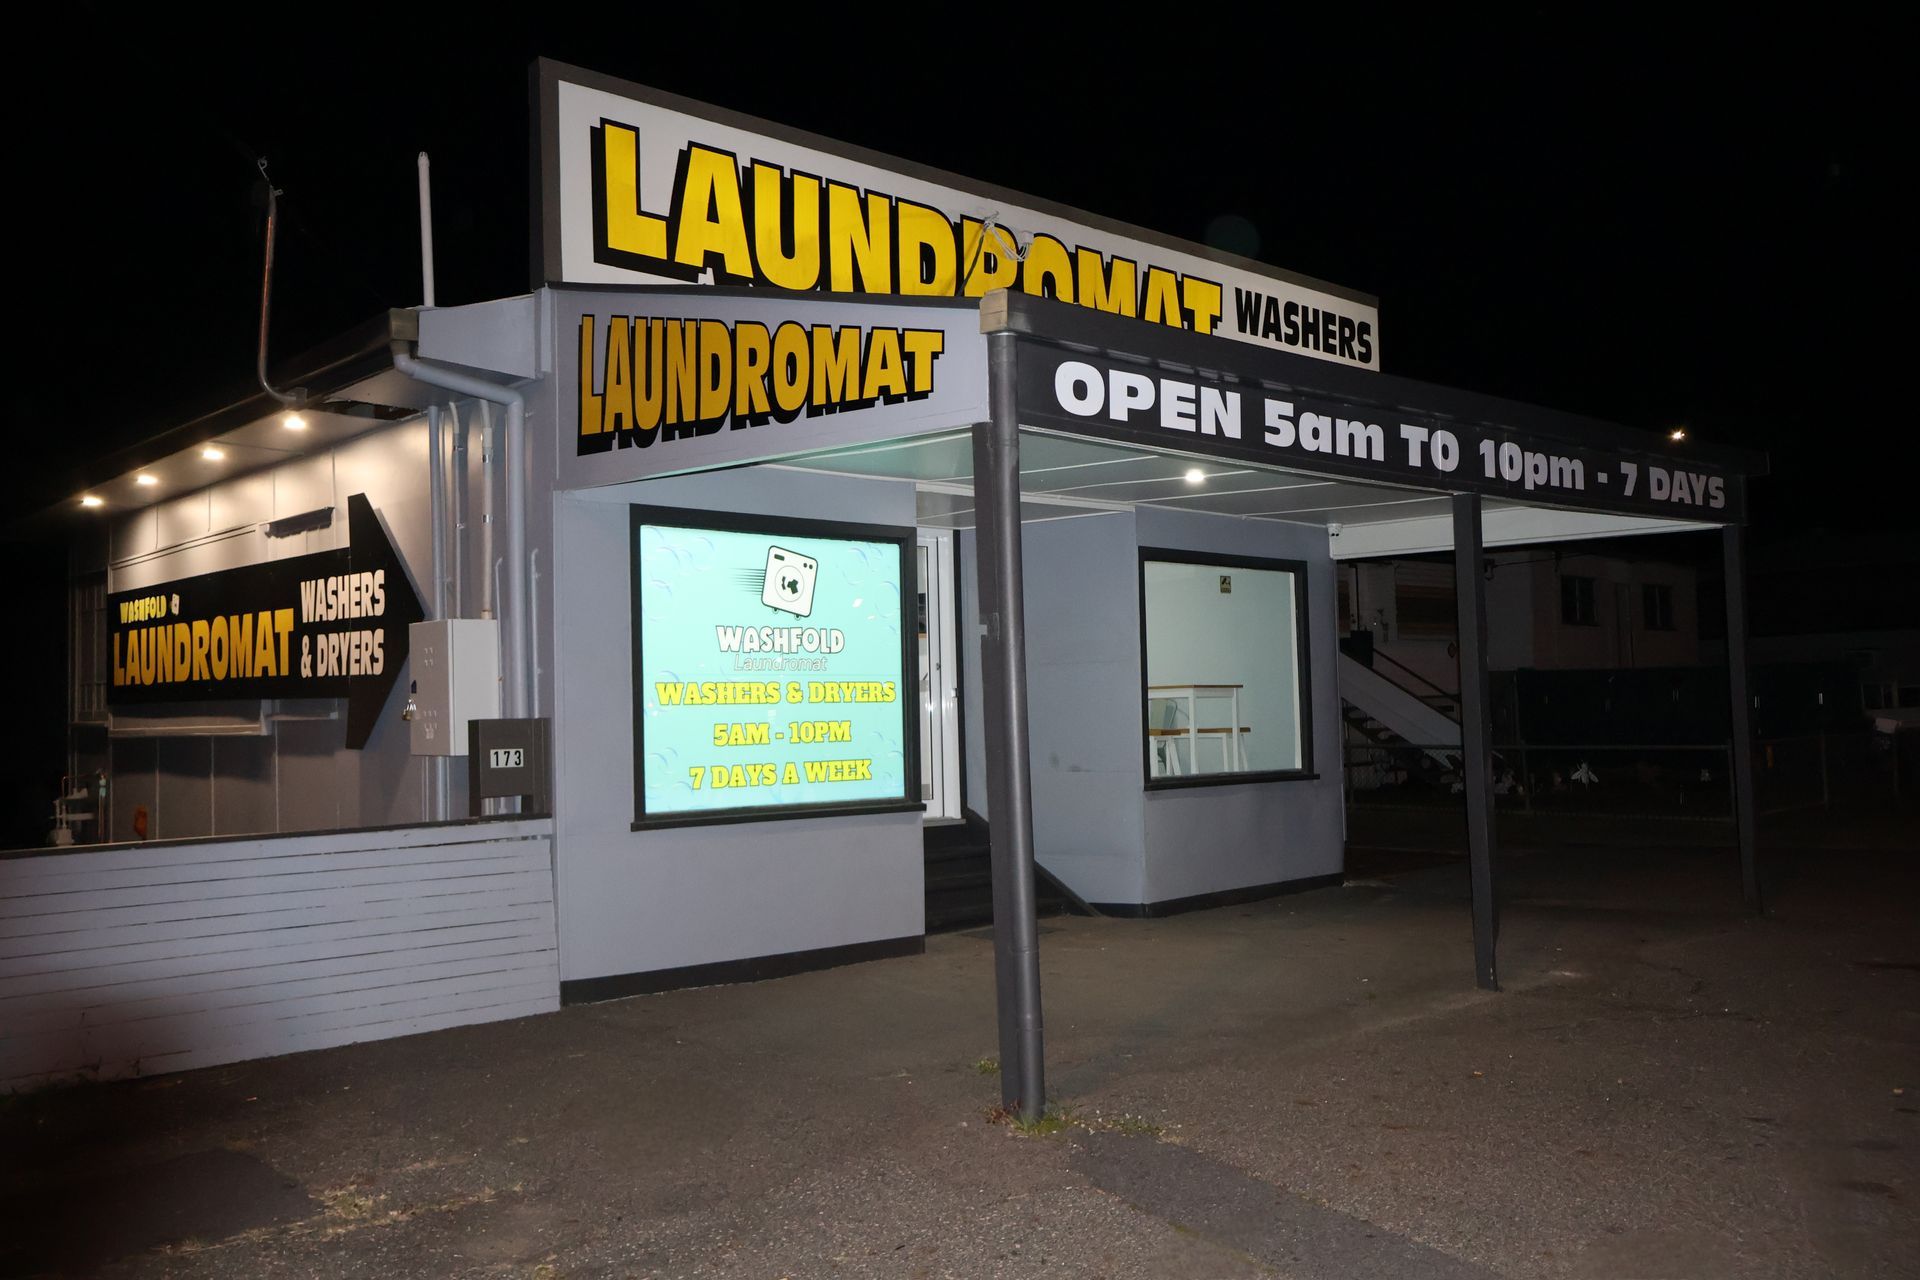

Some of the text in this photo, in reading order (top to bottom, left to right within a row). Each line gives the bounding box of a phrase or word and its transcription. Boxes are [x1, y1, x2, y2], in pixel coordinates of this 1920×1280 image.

[1235, 287, 1372, 364] WASHERS
[577, 314, 944, 456] LAUNDROMAT
[1054, 361, 1726, 509] OPEN 5am TO 10pm - 7 DAYS
[120, 595, 167, 624] WASHFOLD
[300, 569, 385, 623] WASHERS
[113, 607, 294, 687] LAUNDROMAT
[300, 629, 385, 678] & DRYERS
[715, 625, 845, 654] WASHFOLD
[734, 654, 827, 672] Laundromat
[655, 682, 896, 705] WASHERS & DRYERS
[713, 721, 851, 746] 5AM - 10PM
[493, 750, 522, 767] 173
[689, 759, 872, 790] 7 DAYS A WEEK
